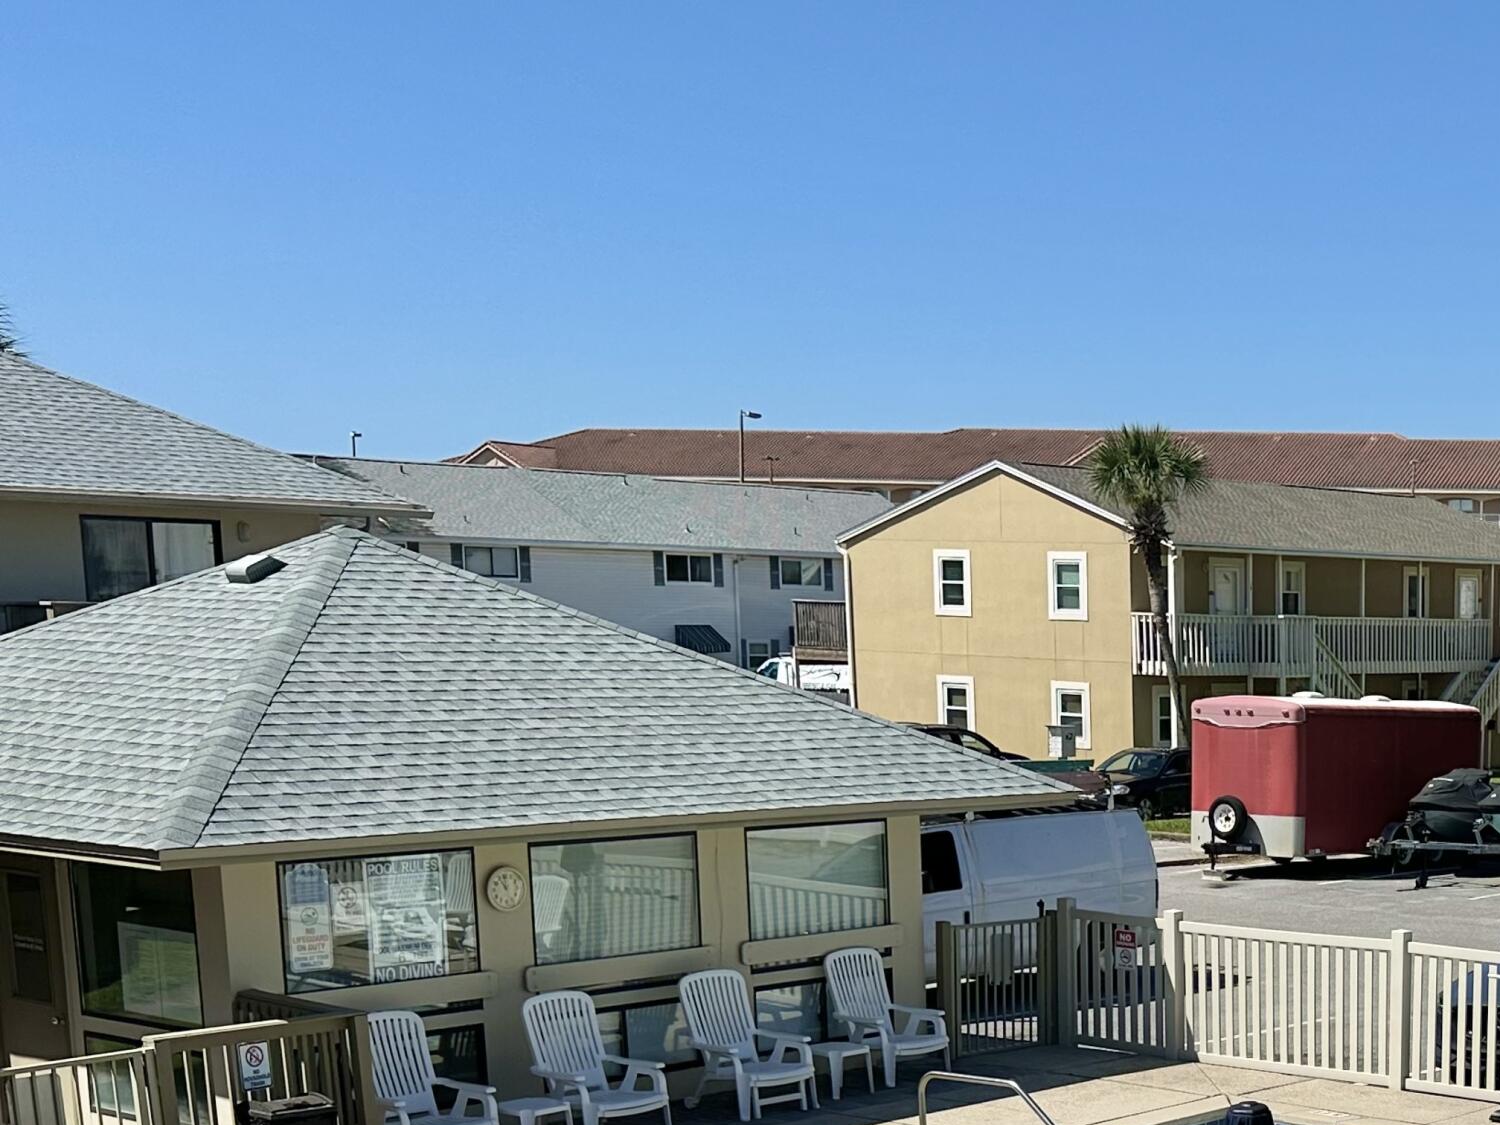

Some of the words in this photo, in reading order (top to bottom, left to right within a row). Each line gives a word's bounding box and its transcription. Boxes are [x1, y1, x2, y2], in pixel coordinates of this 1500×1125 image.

[367, 862, 398, 876] POOL
[401, 858, 438, 873] RULES
[375, 967, 396, 983] NO
[399, 963, 444, 980] DIVING
